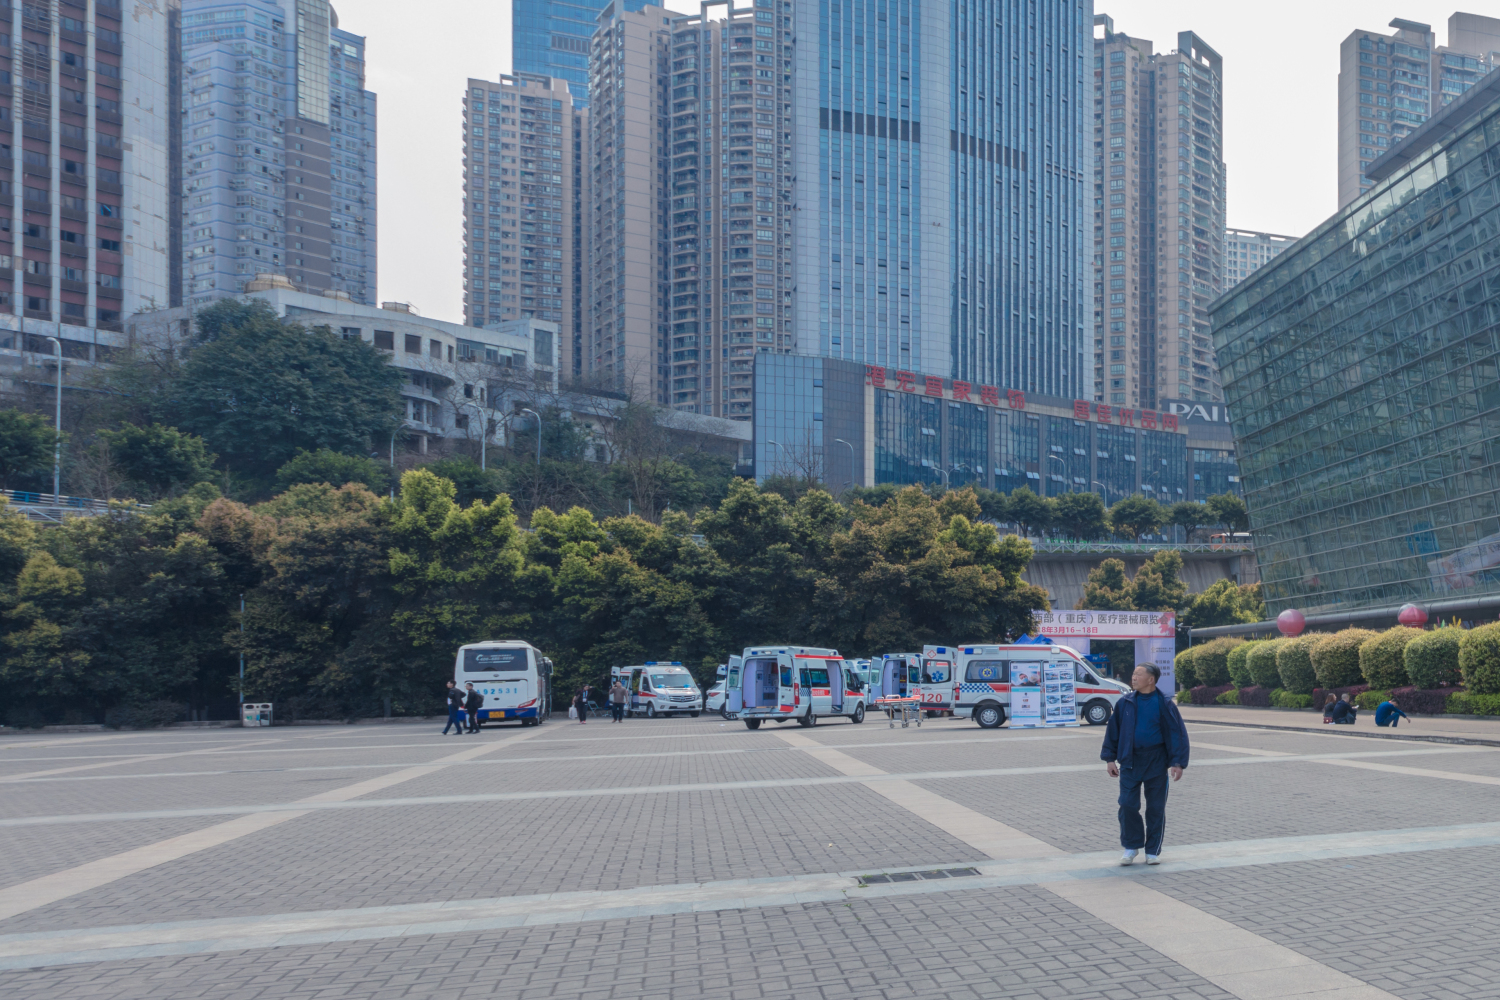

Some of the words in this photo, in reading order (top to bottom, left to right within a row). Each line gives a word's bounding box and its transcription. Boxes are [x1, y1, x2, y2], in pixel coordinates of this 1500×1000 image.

[865, 364, 1026, 410] 港宏宜家装饰
[1073, 399, 1179, 433] 居佳优品网
[1169, 402, 1230, 423] PAI
[920, 693, 943, 703] 120
